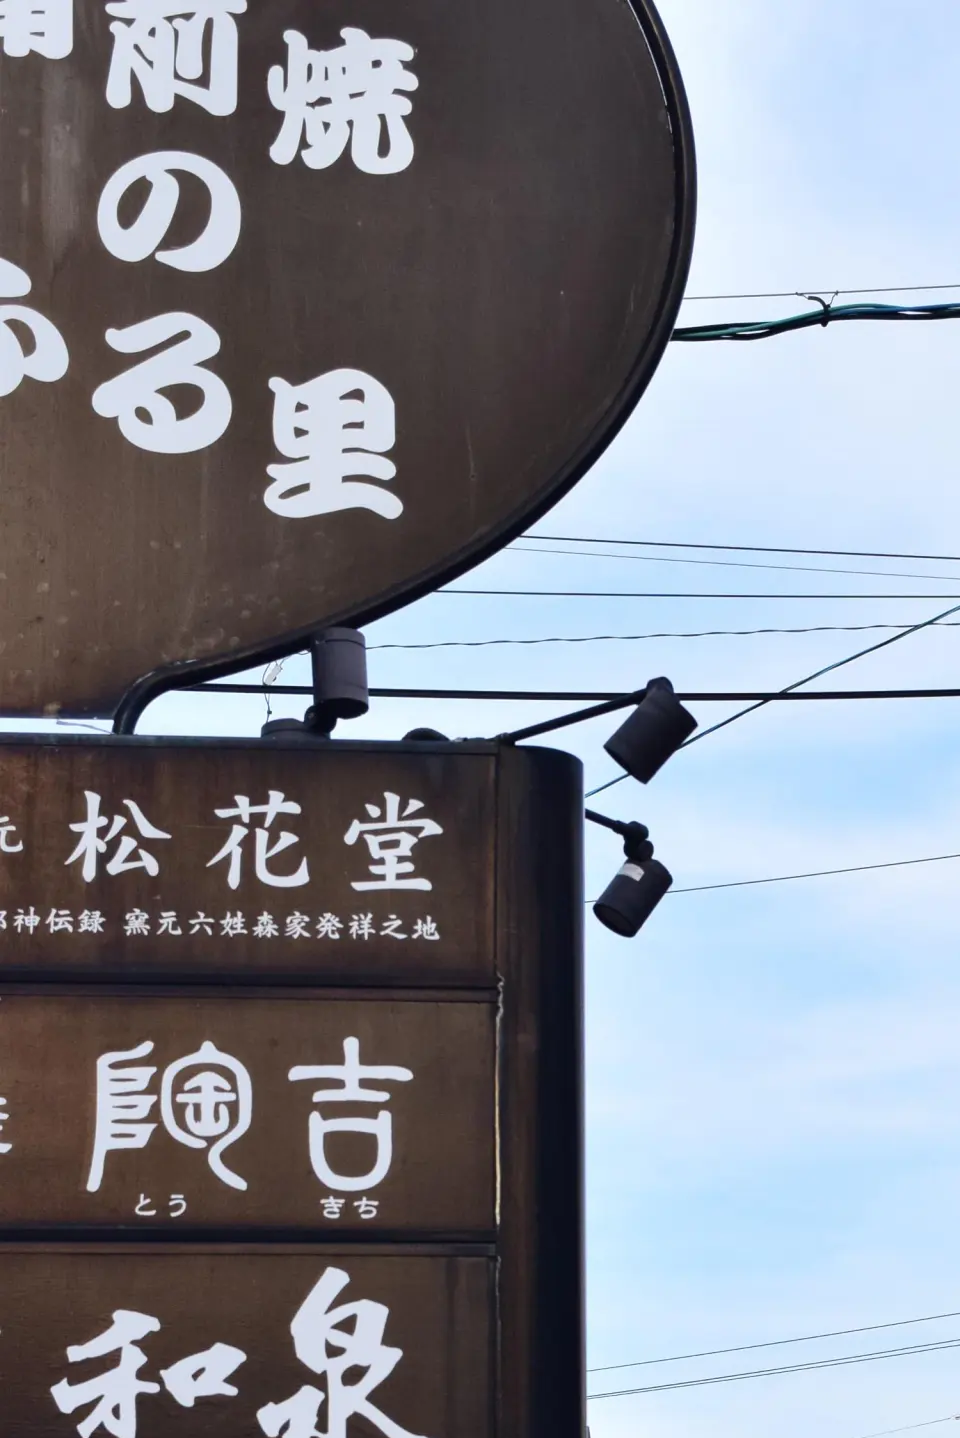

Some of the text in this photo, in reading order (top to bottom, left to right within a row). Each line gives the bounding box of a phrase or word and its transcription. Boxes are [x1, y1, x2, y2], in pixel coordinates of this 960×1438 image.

[65, 790, 443, 891] 松花堂
[134, 1194, 379, 1219] とう きち
